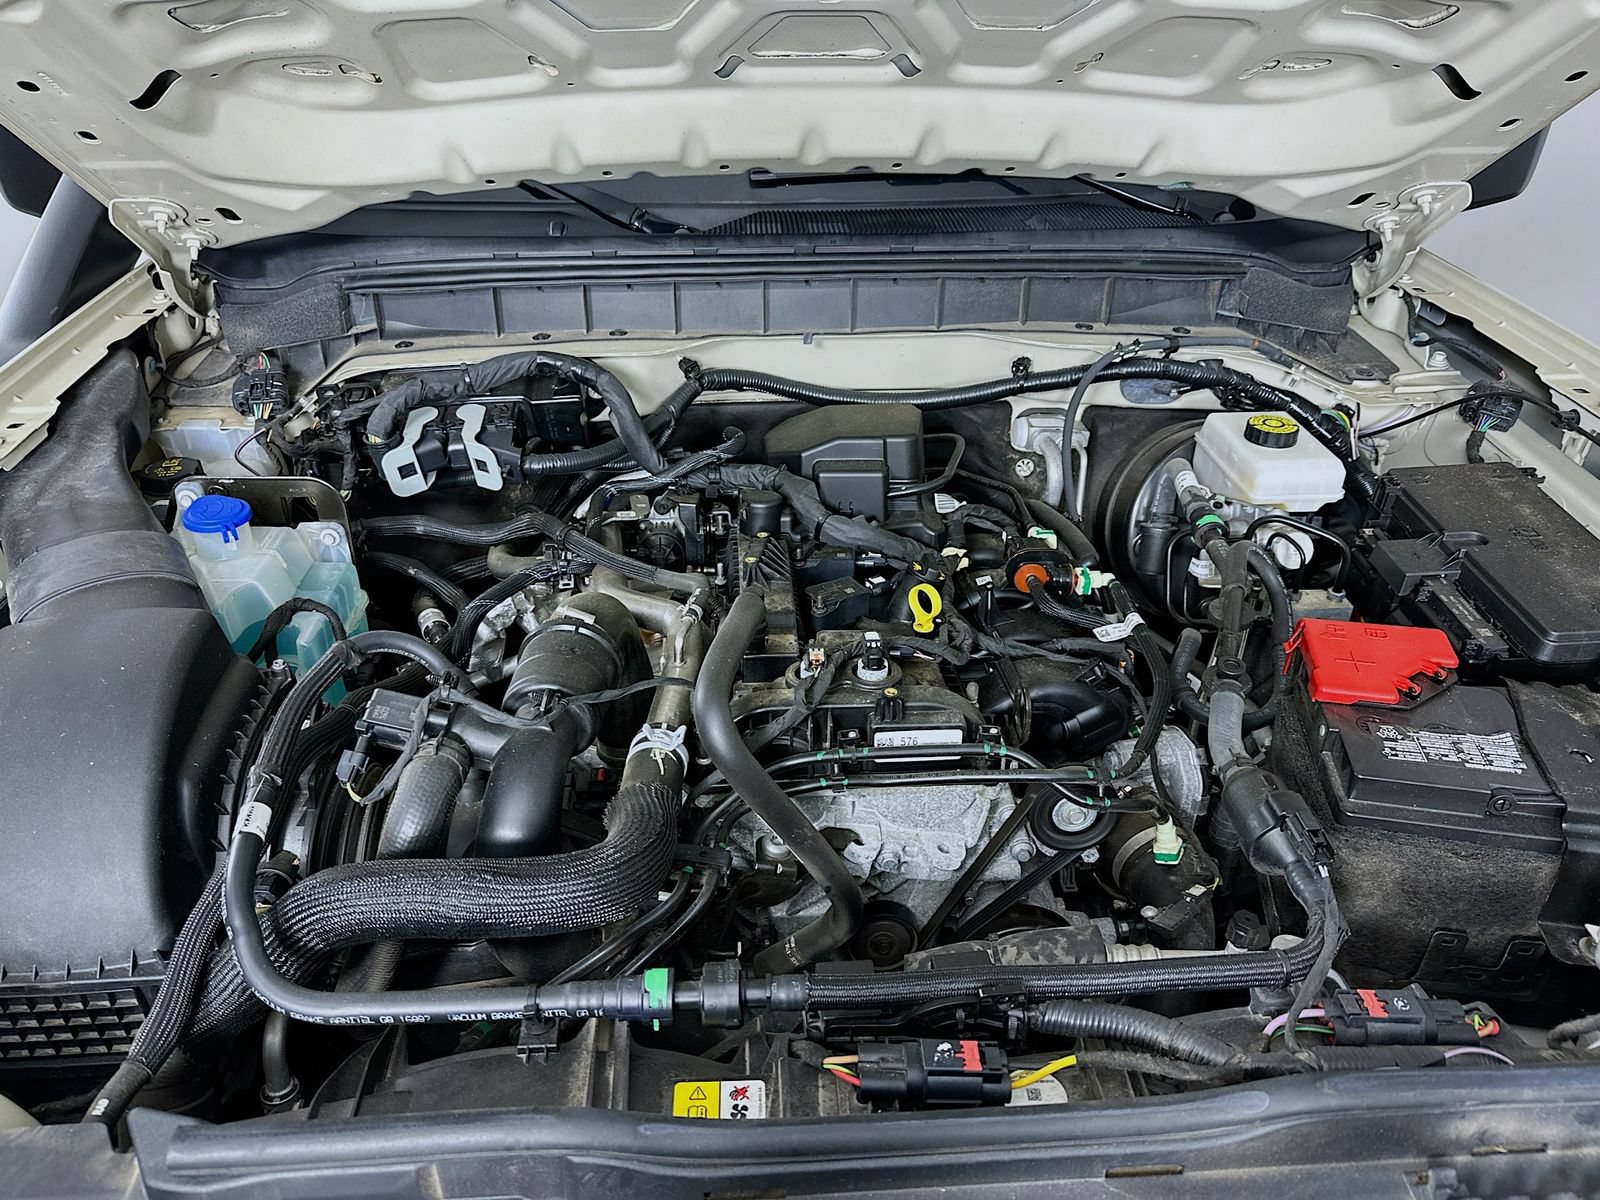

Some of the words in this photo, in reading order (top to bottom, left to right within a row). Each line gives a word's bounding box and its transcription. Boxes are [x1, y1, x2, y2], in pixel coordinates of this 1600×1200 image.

[900, 737, 919, 747] 576
[447, 1013, 487, 1021] VACUUM
[490, 1011, 524, 1020] BRAKE
